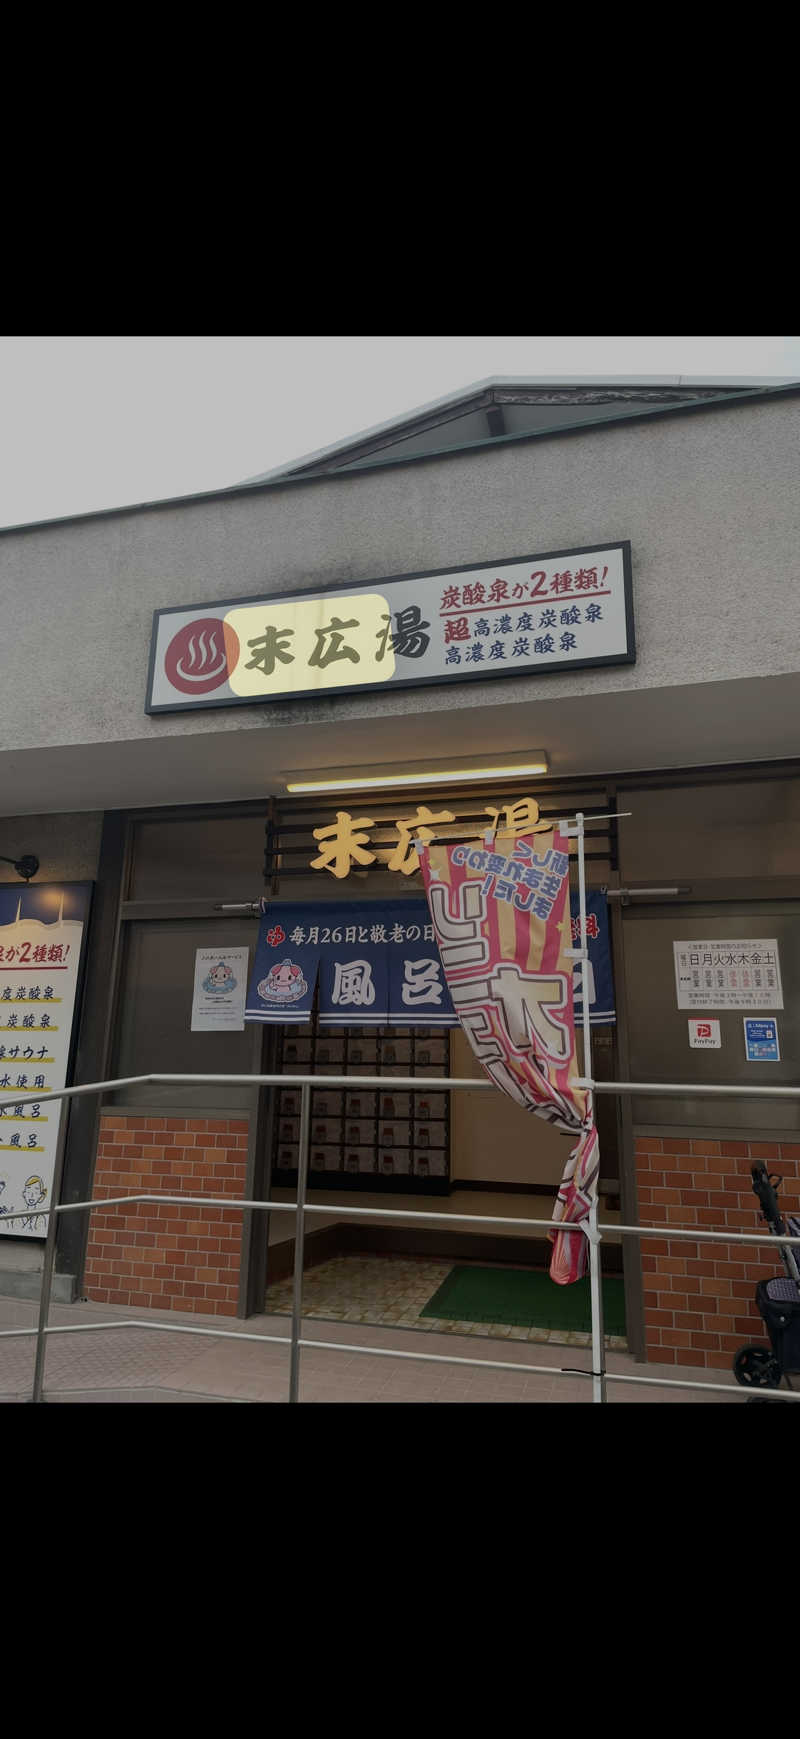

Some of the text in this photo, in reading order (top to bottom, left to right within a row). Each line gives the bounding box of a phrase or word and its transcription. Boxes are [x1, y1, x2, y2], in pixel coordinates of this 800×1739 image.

[440, 566, 608, 610] 炭酸泉が2種類!
[244, 605, 430, 675] 末広湯
[444, 603, 603, 644] 超高濃度炭酸泉
[445, 631, 578, 665] 高濃度炭酸泉
[0, 1132, 38, 1149] 風呂
